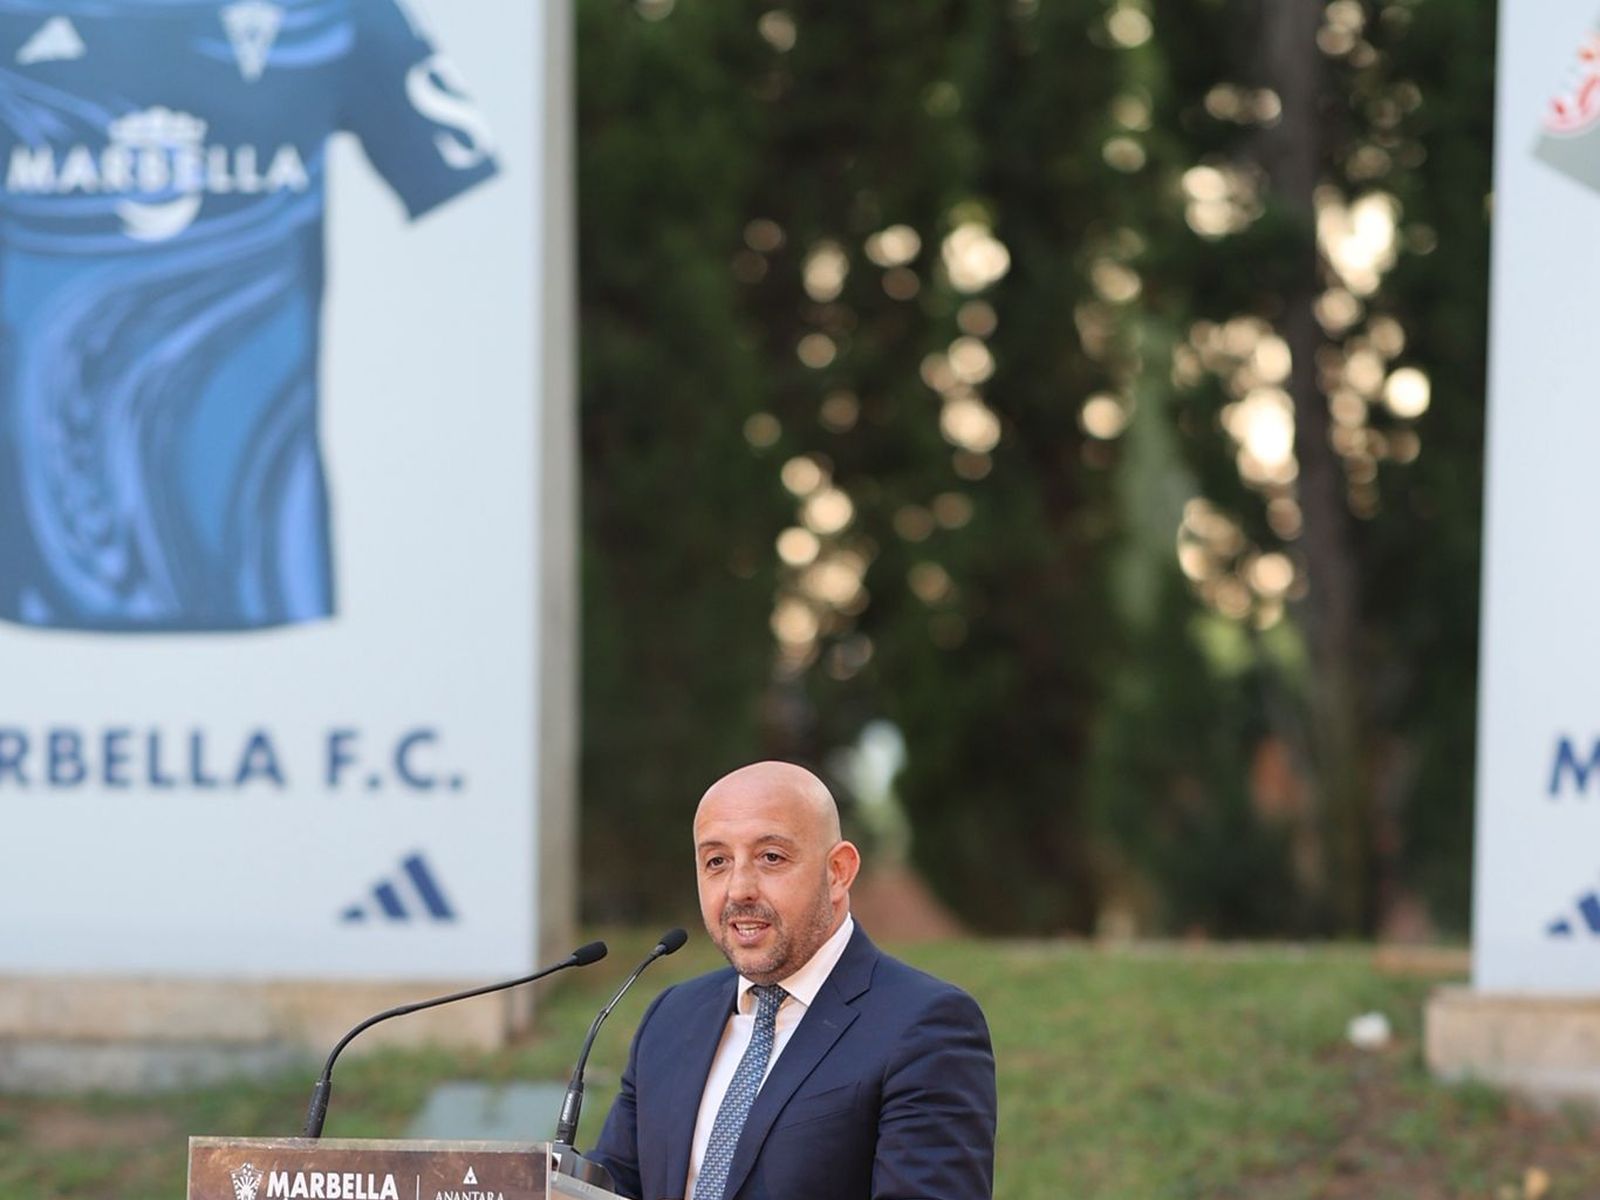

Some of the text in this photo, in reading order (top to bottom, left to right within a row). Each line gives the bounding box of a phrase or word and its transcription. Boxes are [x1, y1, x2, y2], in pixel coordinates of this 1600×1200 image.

[6, 144, 309, 194] MARBELLA
[0, 727, 466, 790] RBELLA F.C.
[266, 1171, 399, 1200] MARBELLA
